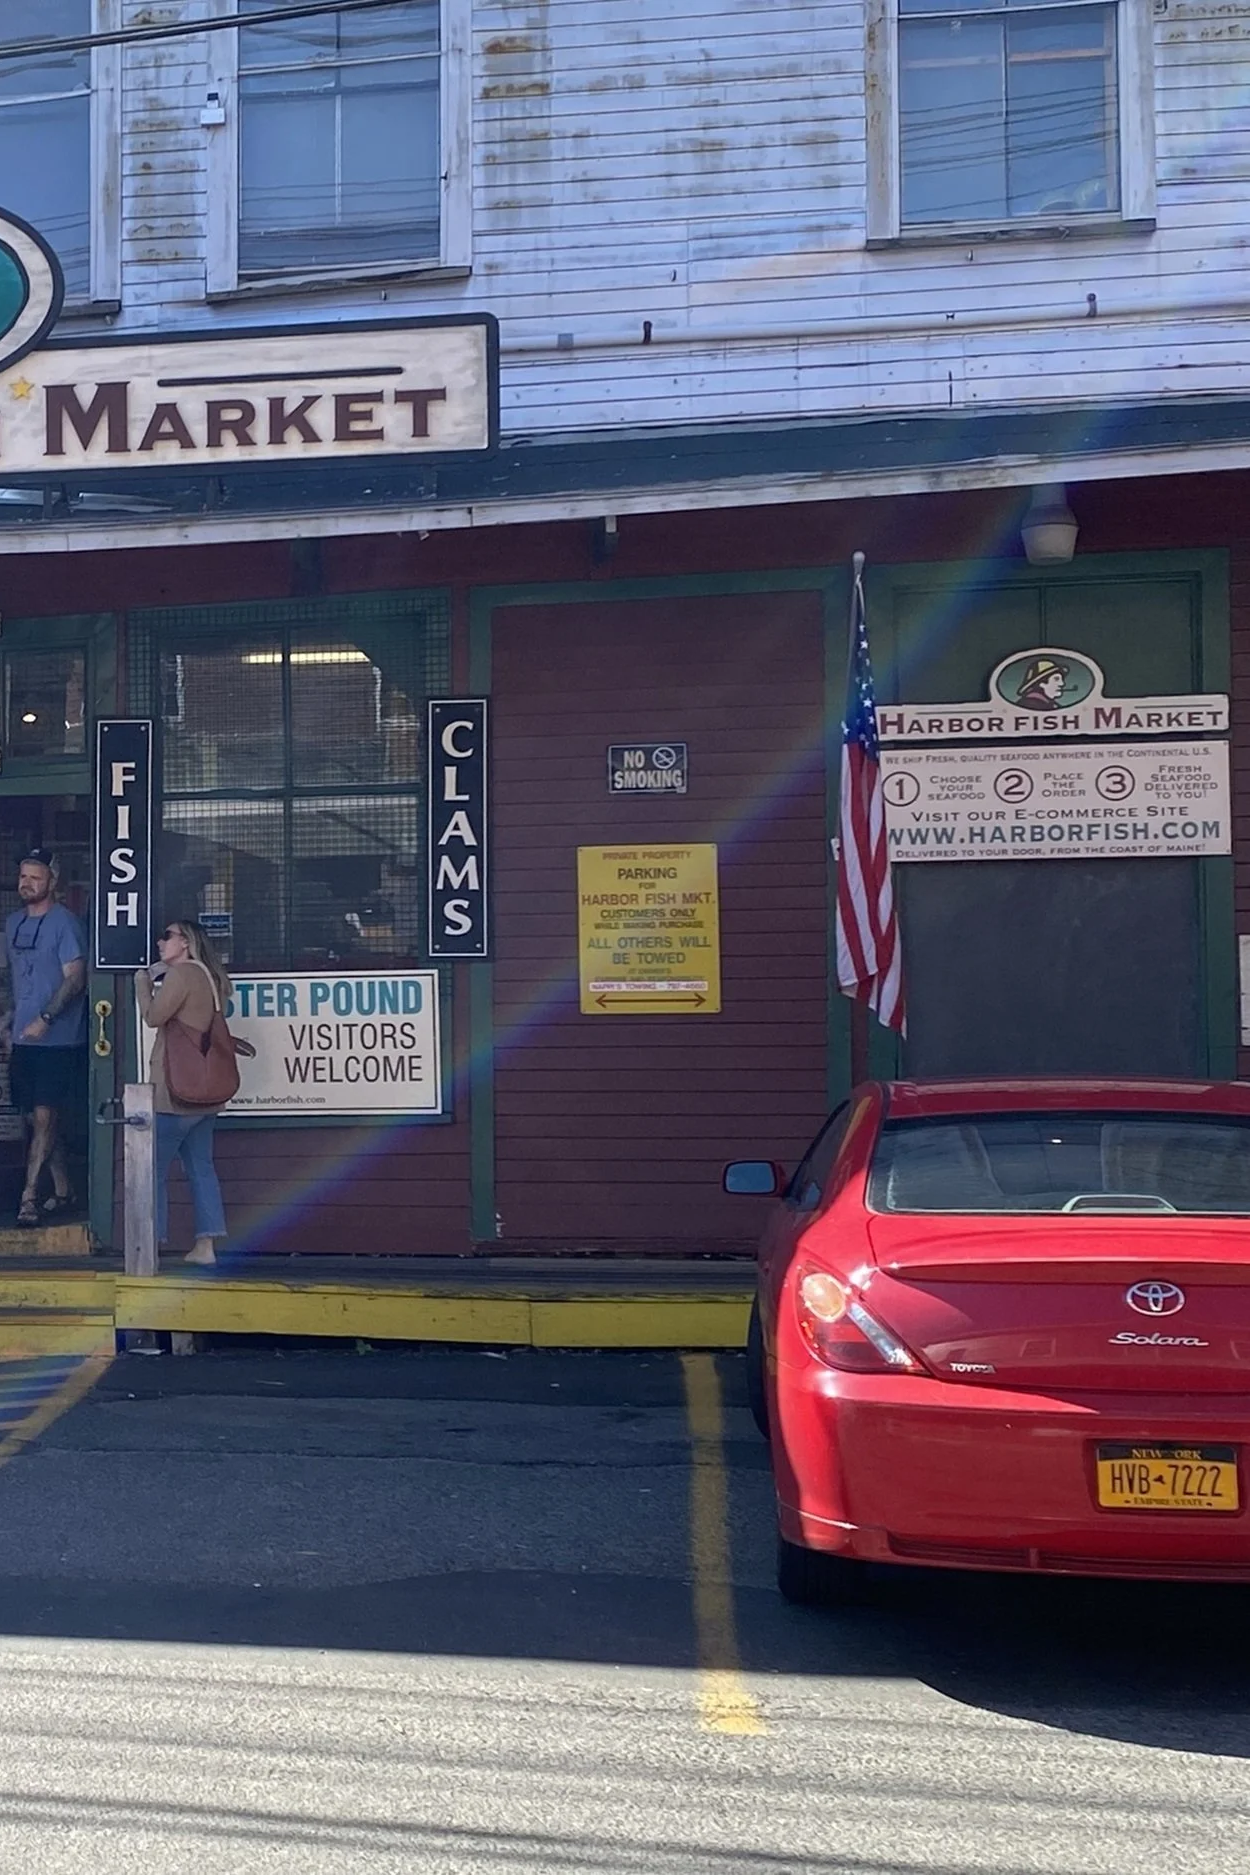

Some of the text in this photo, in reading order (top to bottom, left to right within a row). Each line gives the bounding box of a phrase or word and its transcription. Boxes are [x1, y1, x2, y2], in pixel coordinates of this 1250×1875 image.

[43, 380, 447, 456] MARKET
[880, 707, 1223, 735] HARBOR FISH MARKET
[623, 750, 645, 768] NO
[885, 756, 899, 764] WE
[902, 756, 923, 764] SHIP
[960, 754, 997, 762] QUALITY
[1000, 753, 1040, 761] SEAFOOD
[1042, 751, 1092, 760] ANYWHERE
[1107, 750, 1123, 758] THE
[1126, 749, 1189, 757] CONTINENTAL
[1192, 747, 1212, 756] U.S.
[1159, 765, 1202, 773] FRESH
[614, 770, 683, 789] SMOKING
[929, 775, 982, 784] CHOOSE
[1043, 772, 1084, 781] PLACE
[1105, 772, 1127, 794] 3
[1151, 773, 1212, 782] SEAFOOD
[895, 778, 904, 800] 1
[939, 784, 973, 792] YOUR
[1003, 774, 1025, 796] 2
[1144, 782, 1218, 791] DELIVERED
[927, 792, 985, 800] SEAFOOD
[1041, 789, 1086, 797] ORDER
[1176, 790, 1207, 799] YOU!
[911, 806, 1189, 822] VISIT OUR E-COMMERCE SITE
[436, 720, 479, 936] CLAMS
[888, 821, 1220, 845] WWW.HARBORFISH.COM
[106, 762, 138, 926] FISH
[896, 850, 957, 858] DELIVERED
[961, 849, 975, 857] TO
[978, 849, 1009, 857] YOUR
[1050, 846, 1080, 854] FROM
[1085, 846, 1106, 854] THE
[1166, 844, 1206, 852] MAINE!
[603, 851, 691, 860] PRIVATE PROPERTY
[617, 868, 677, 880] PARKING
[582, 894, 639, 905] HARBOR
[645, 893, 676, 904] FISH
[600, 908, 696, 919] CUSTOMERS ONLY
[587, 936, 711, 949] ALL OTHERS WILL
[612, 952, 686, 965] BE TOWED
[310, 980, 423, 1016] POUND
[288, 1022, 416, 1050] VISITORS
[284, 1055, 423, 1083] WELCOME
[231, 1095, 326, 1104] www.harborfish.com
[1108, 1332, 1209, 1346] Solara
[1132, 1449, 1202, 1460] NEW ORK
[1111, 1463, 1223, 1497] HVB 7222
